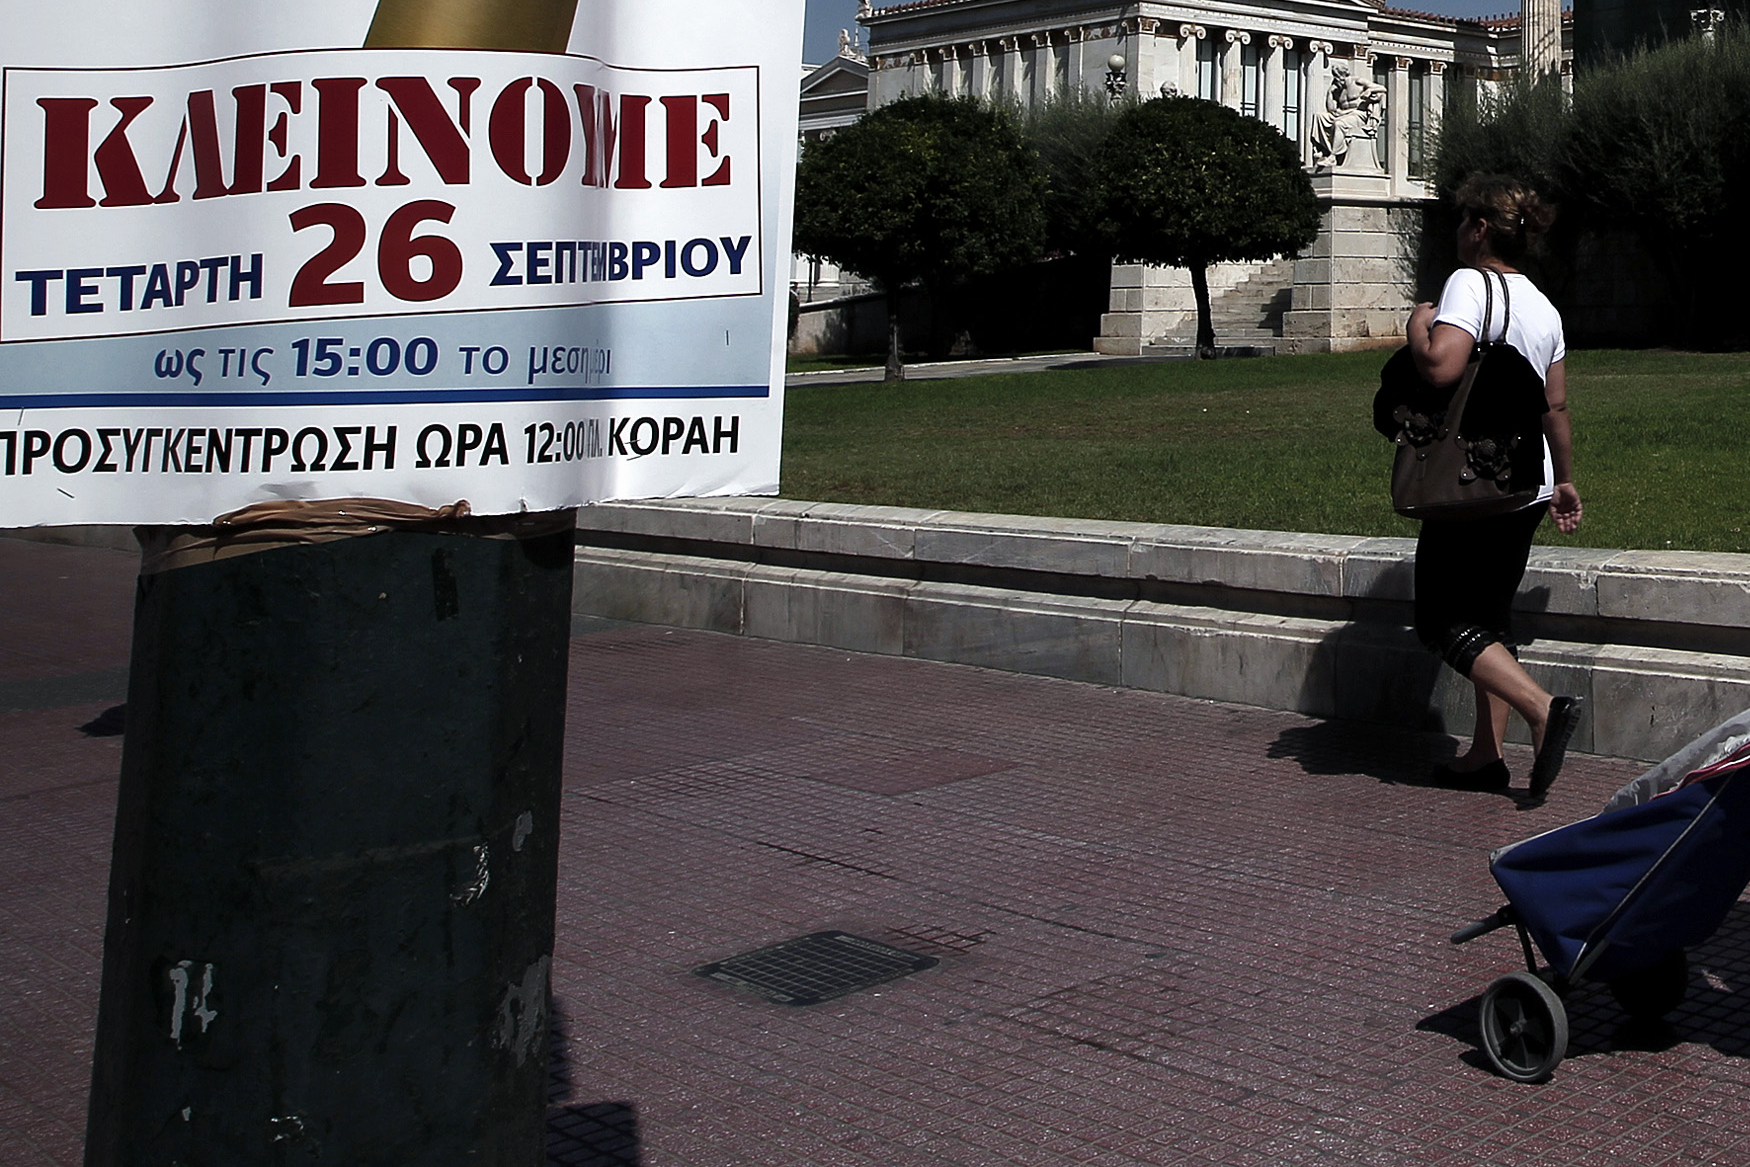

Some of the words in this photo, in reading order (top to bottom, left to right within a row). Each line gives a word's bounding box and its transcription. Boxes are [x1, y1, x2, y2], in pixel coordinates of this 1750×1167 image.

[33, 76, 731, 210] ΚΛΕΙΝΟΥΜΕ
[15, 253, 263, 317] ΤΕΤΑΡΤΗ
[288, 200, 463, 308] 26
[489, 235, 752, 287] ΣΕΠΤΕΜΒΡΙΟΥ
[153, 345, 205, 386] ως
[219, 345, 273, 386] τις
[292, 336, 439, 377] 15:00
[459, 345, 509, 376] το
[414, 422, 509, 470] ΩΡΑ
[524, 420, 585, 464] 12:00
[608, 415, 740, 457] ΚΟΡΑΗ
